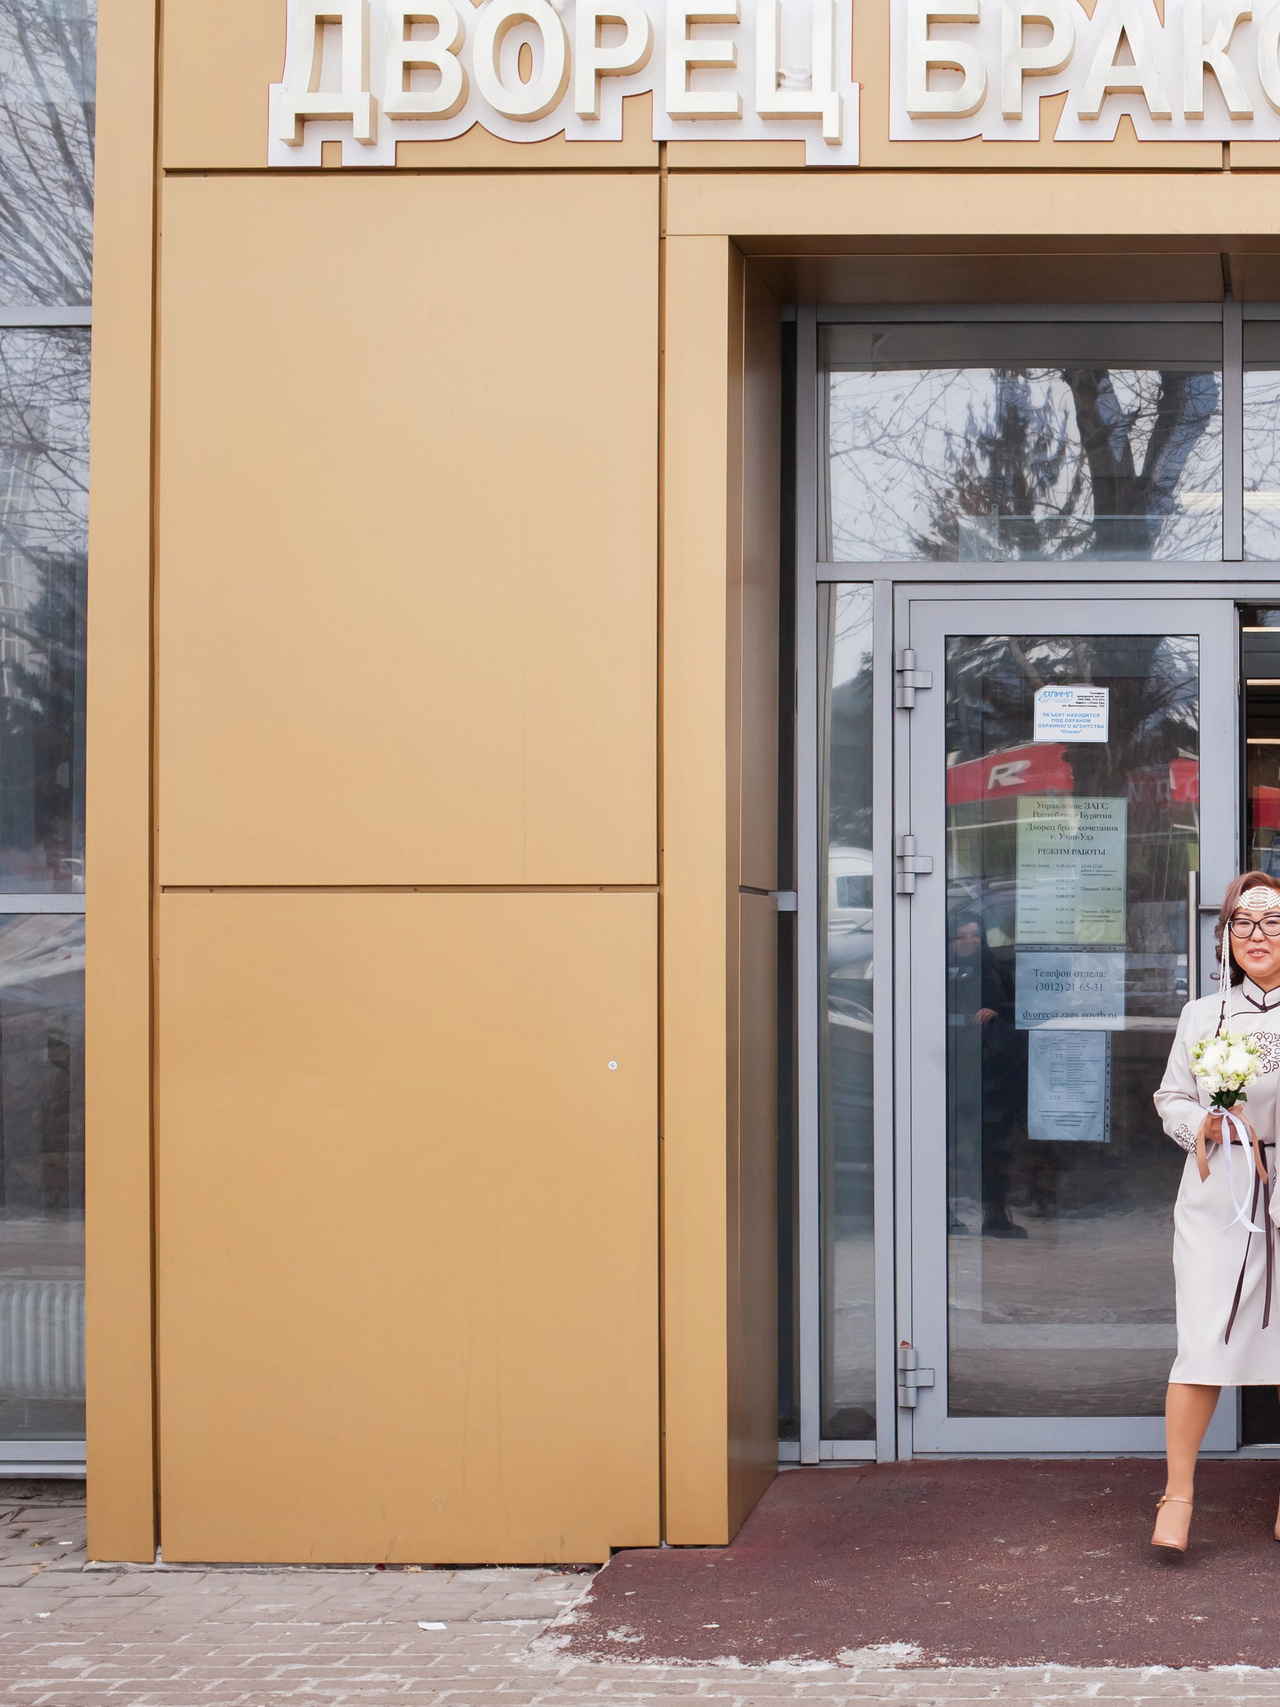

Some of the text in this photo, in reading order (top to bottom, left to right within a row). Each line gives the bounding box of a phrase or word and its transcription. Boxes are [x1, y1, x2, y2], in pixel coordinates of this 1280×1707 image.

[278, 0, 845, 146] ДВОРЕЦ
[1084, 802, 1109, 810] ЗАГС
[1080, 812, 1112, 820] Бурятия
[1025, 823, 1119, 833] Дворец брасочетания
[1059, 833, 1094, 841] Улан-Удэ
[1037, 848, 1106, 856] РЕЖИМ РАБОТЫ
[1033, 969, 1107, 979] Телефон отдела:
[1035, 983, 1103, 992] (3012) 21-65-31
